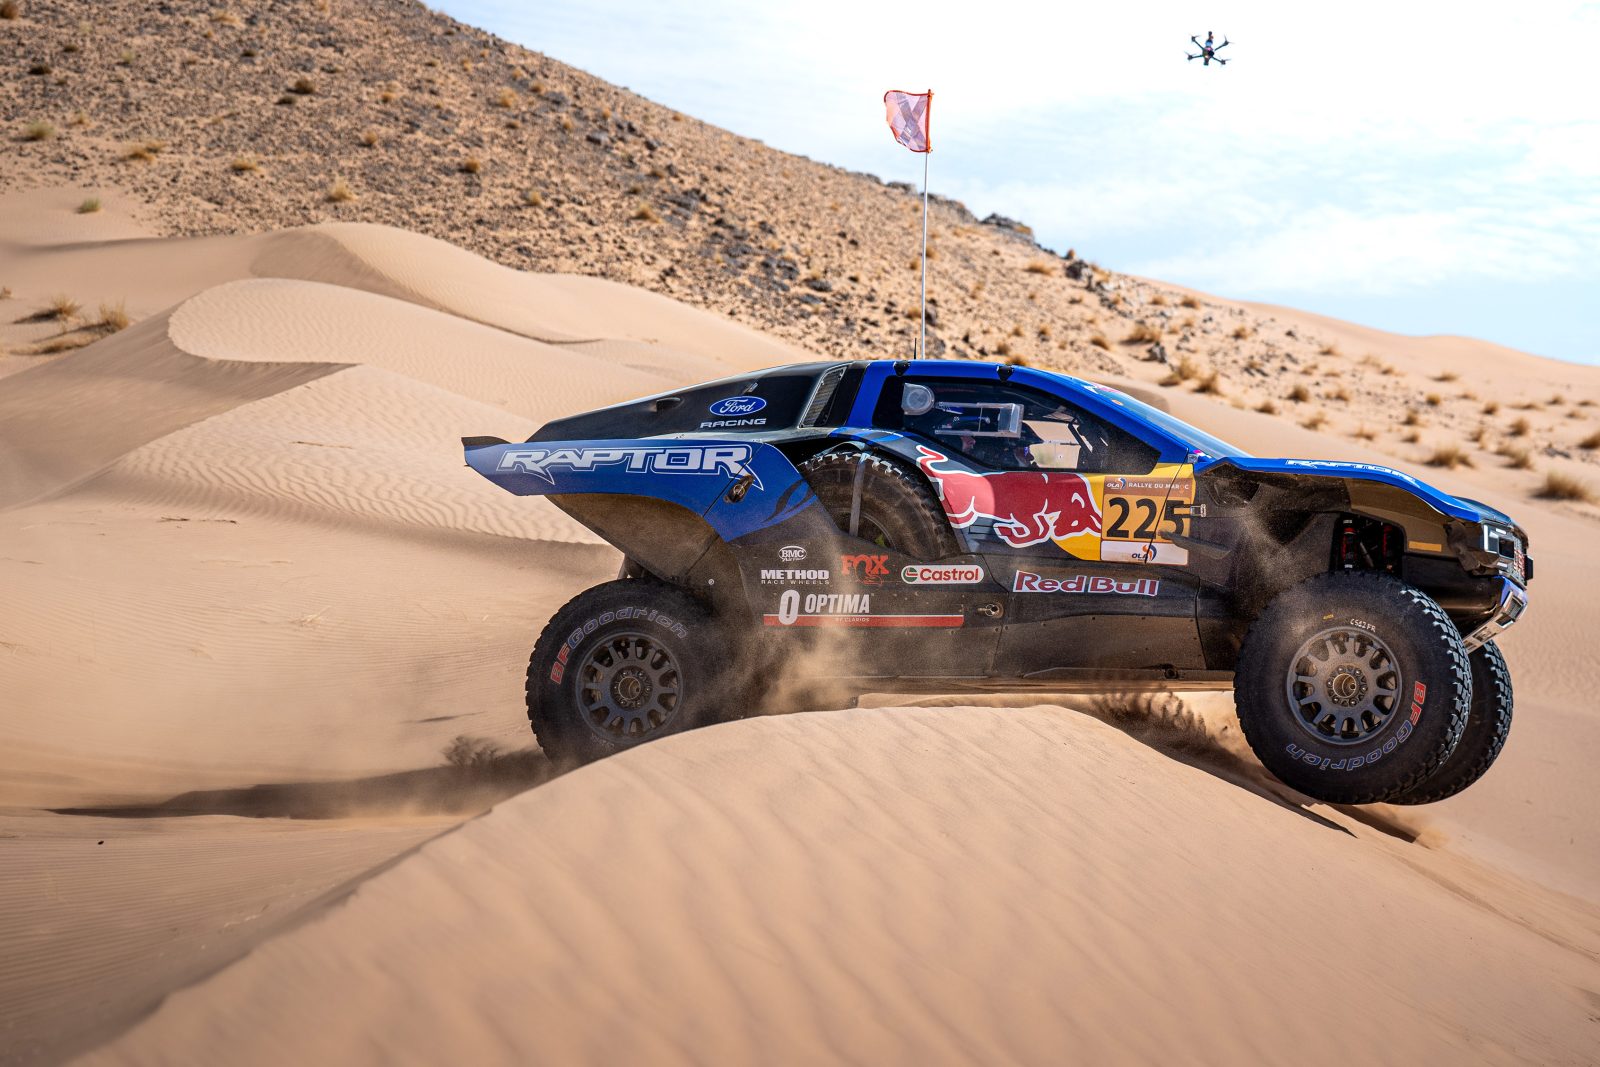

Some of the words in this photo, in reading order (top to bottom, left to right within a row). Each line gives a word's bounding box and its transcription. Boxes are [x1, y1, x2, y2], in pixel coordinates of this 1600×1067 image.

[720, 399, 756, 413] Ford
[700, 418, 767, 428] RACING
[496, 445, 763, 491] RAPTOR
[1106, 497, 1185, 539] 225
[761, 569, 830, 580] METHOD
[841, 554, 890, 582] FOX
[919, 567, 979, 581] Castrol
[1013, 570, 1086, 593] Red
[1087, 576, 1160, 597] Bull
[804, 593, 870, 614] OPTIMA
[550, 606, 688, 685] BFGoodrich
[1286, 681, 1427, 771] BFGoodrich
